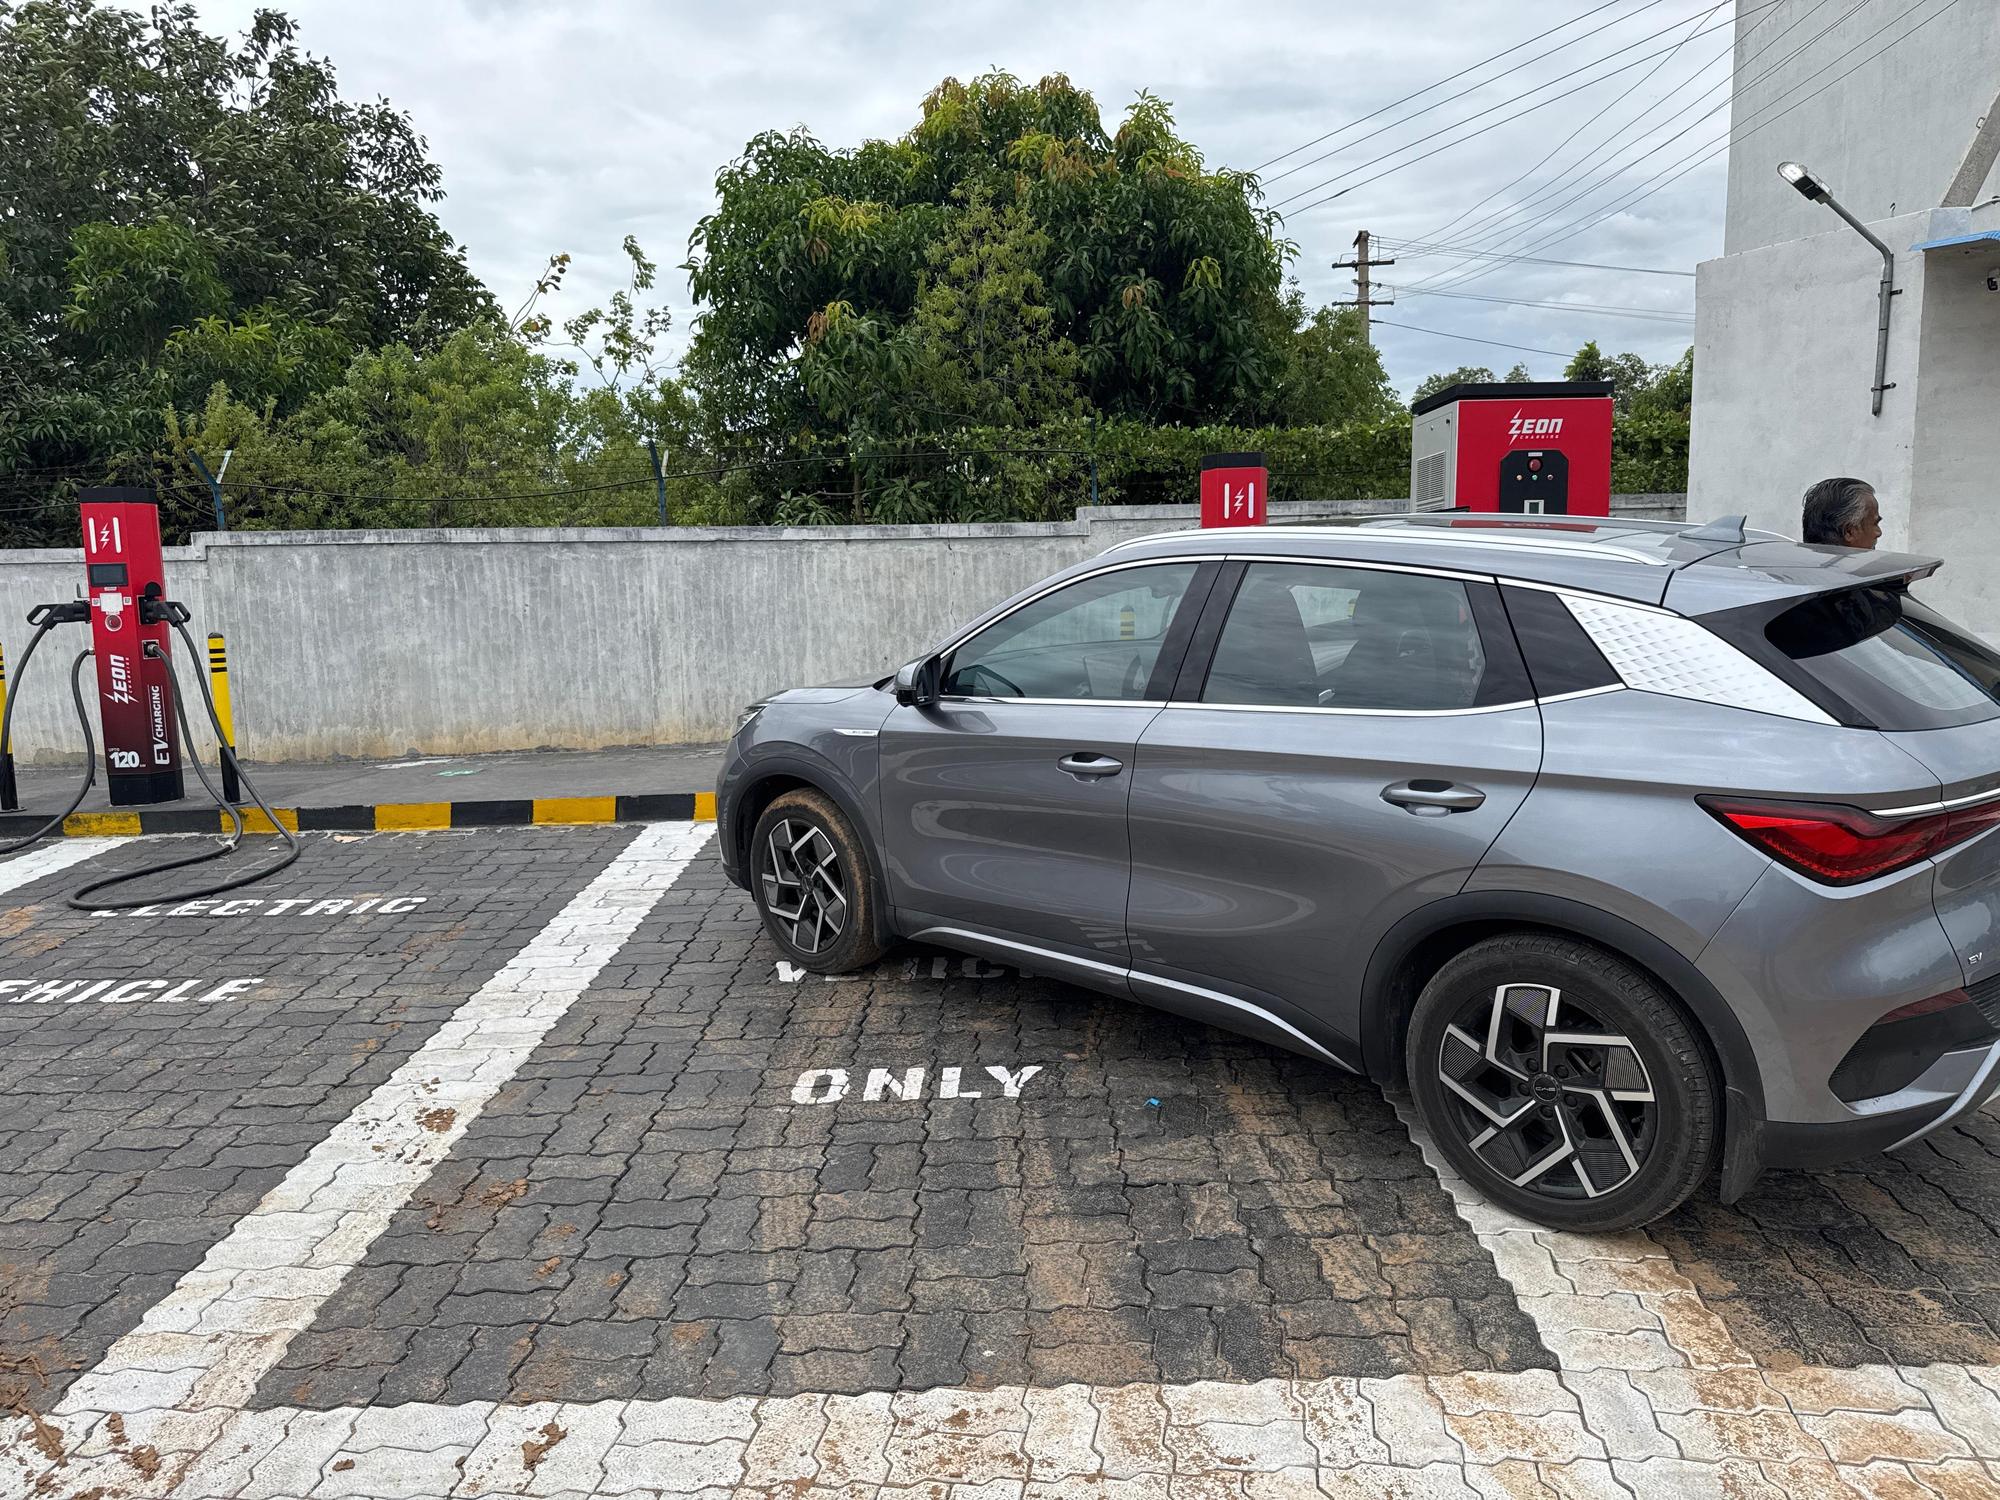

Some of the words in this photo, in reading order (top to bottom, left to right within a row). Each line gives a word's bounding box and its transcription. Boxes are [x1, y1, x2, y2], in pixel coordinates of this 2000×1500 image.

[152, 685, 164, 738] CHARGING
[110, 751, 140, 768] 120
[153, 736, 170, 765] EV
[91, 897, 427, 916] LECTRIC
[791, 1065, 1044, 1104] ONLY
